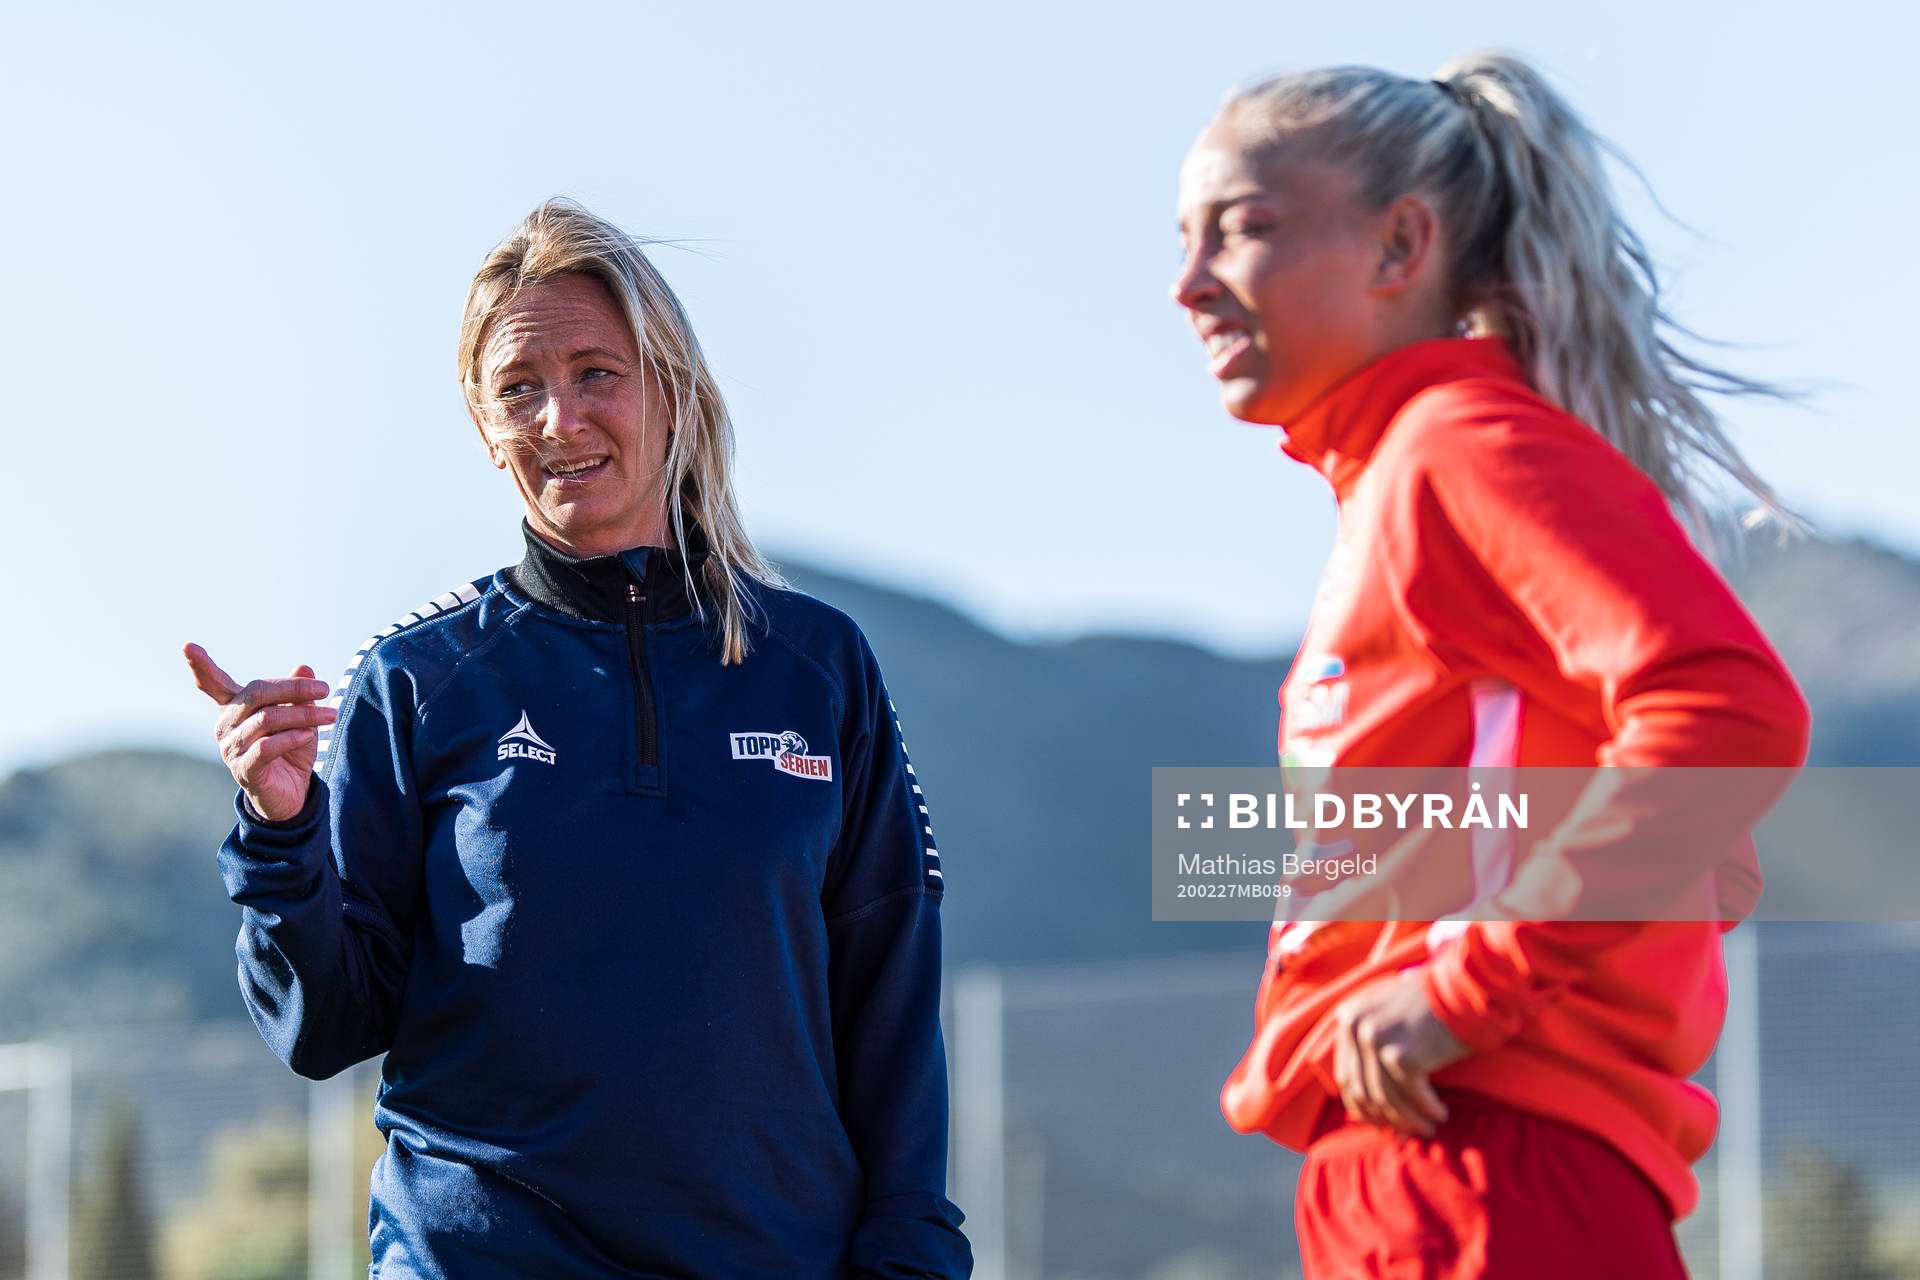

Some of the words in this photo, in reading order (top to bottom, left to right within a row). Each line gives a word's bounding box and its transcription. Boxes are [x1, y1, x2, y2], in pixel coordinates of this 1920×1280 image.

[497, 743, 556, 765] SELECT
[735, 736, 783, 757] TOPP
[780, 752, 829, 777] SERIEN
